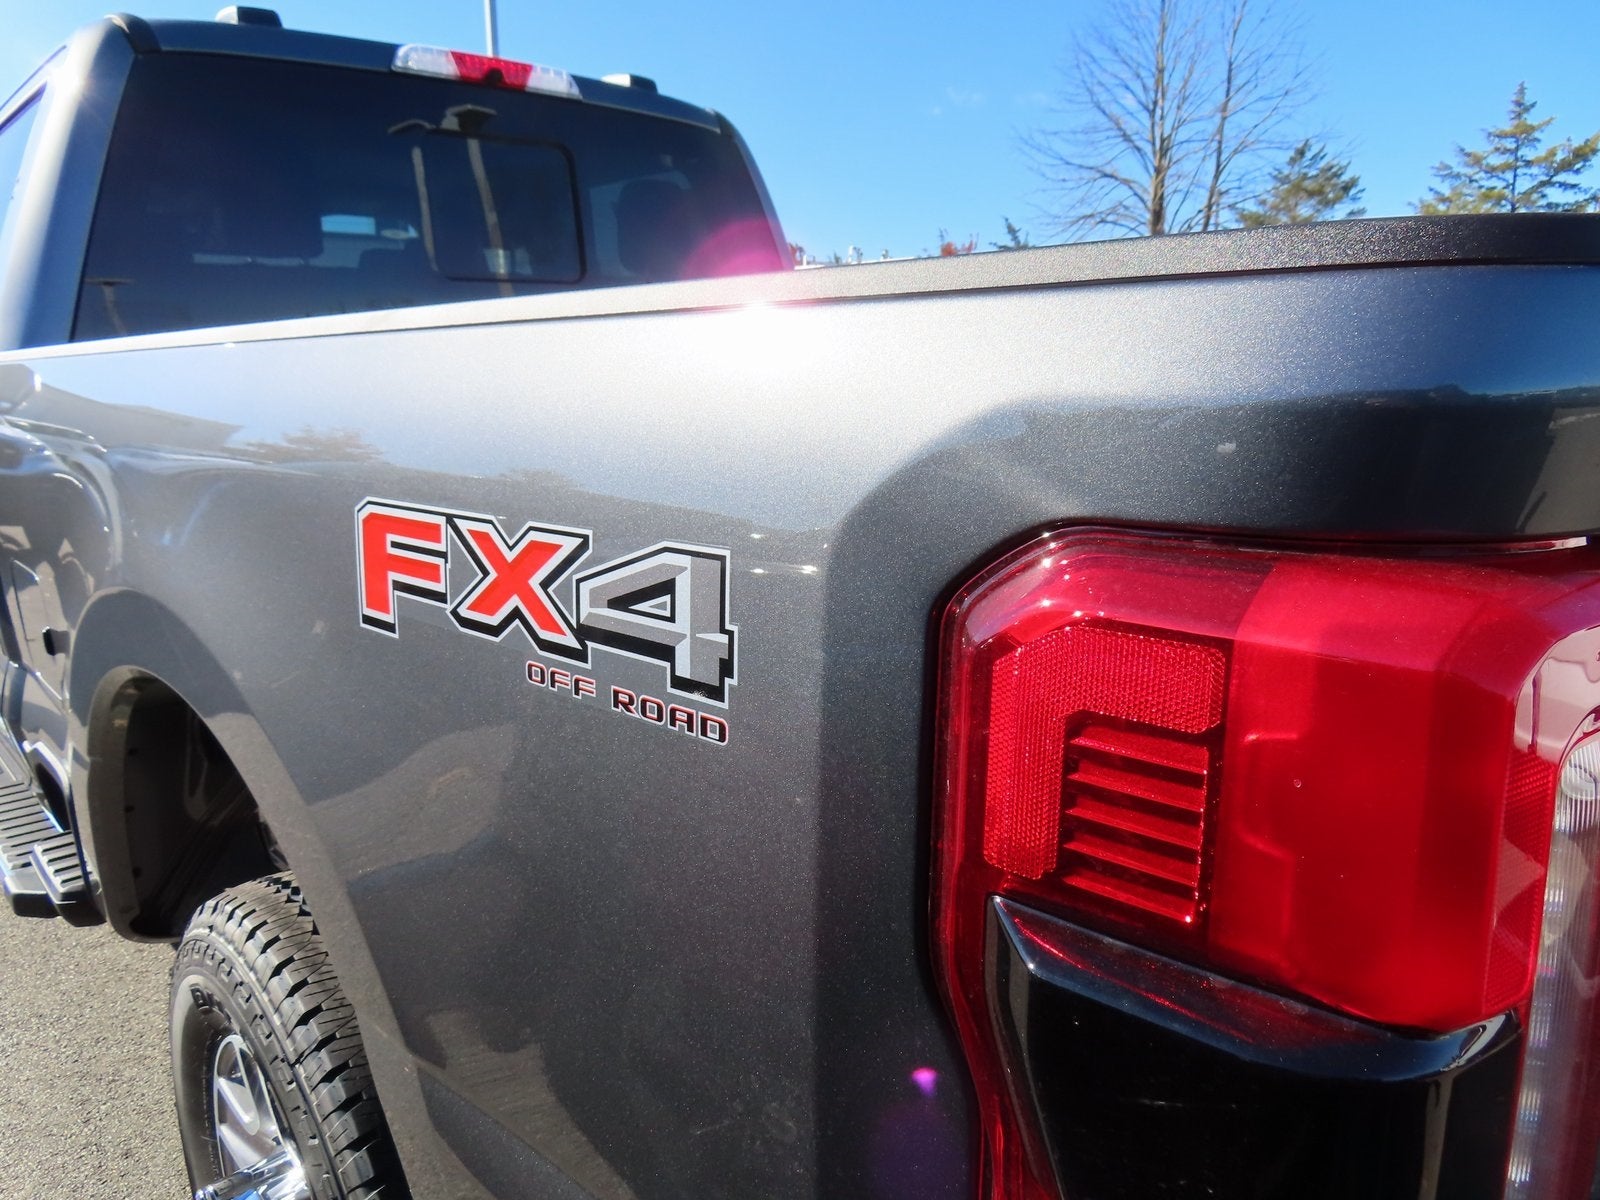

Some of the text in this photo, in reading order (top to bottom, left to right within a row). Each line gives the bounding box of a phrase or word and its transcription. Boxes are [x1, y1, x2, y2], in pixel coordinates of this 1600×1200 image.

[355, 497, 738, 709] FX4
[526, 660, 729, 746] OFF ROAD
